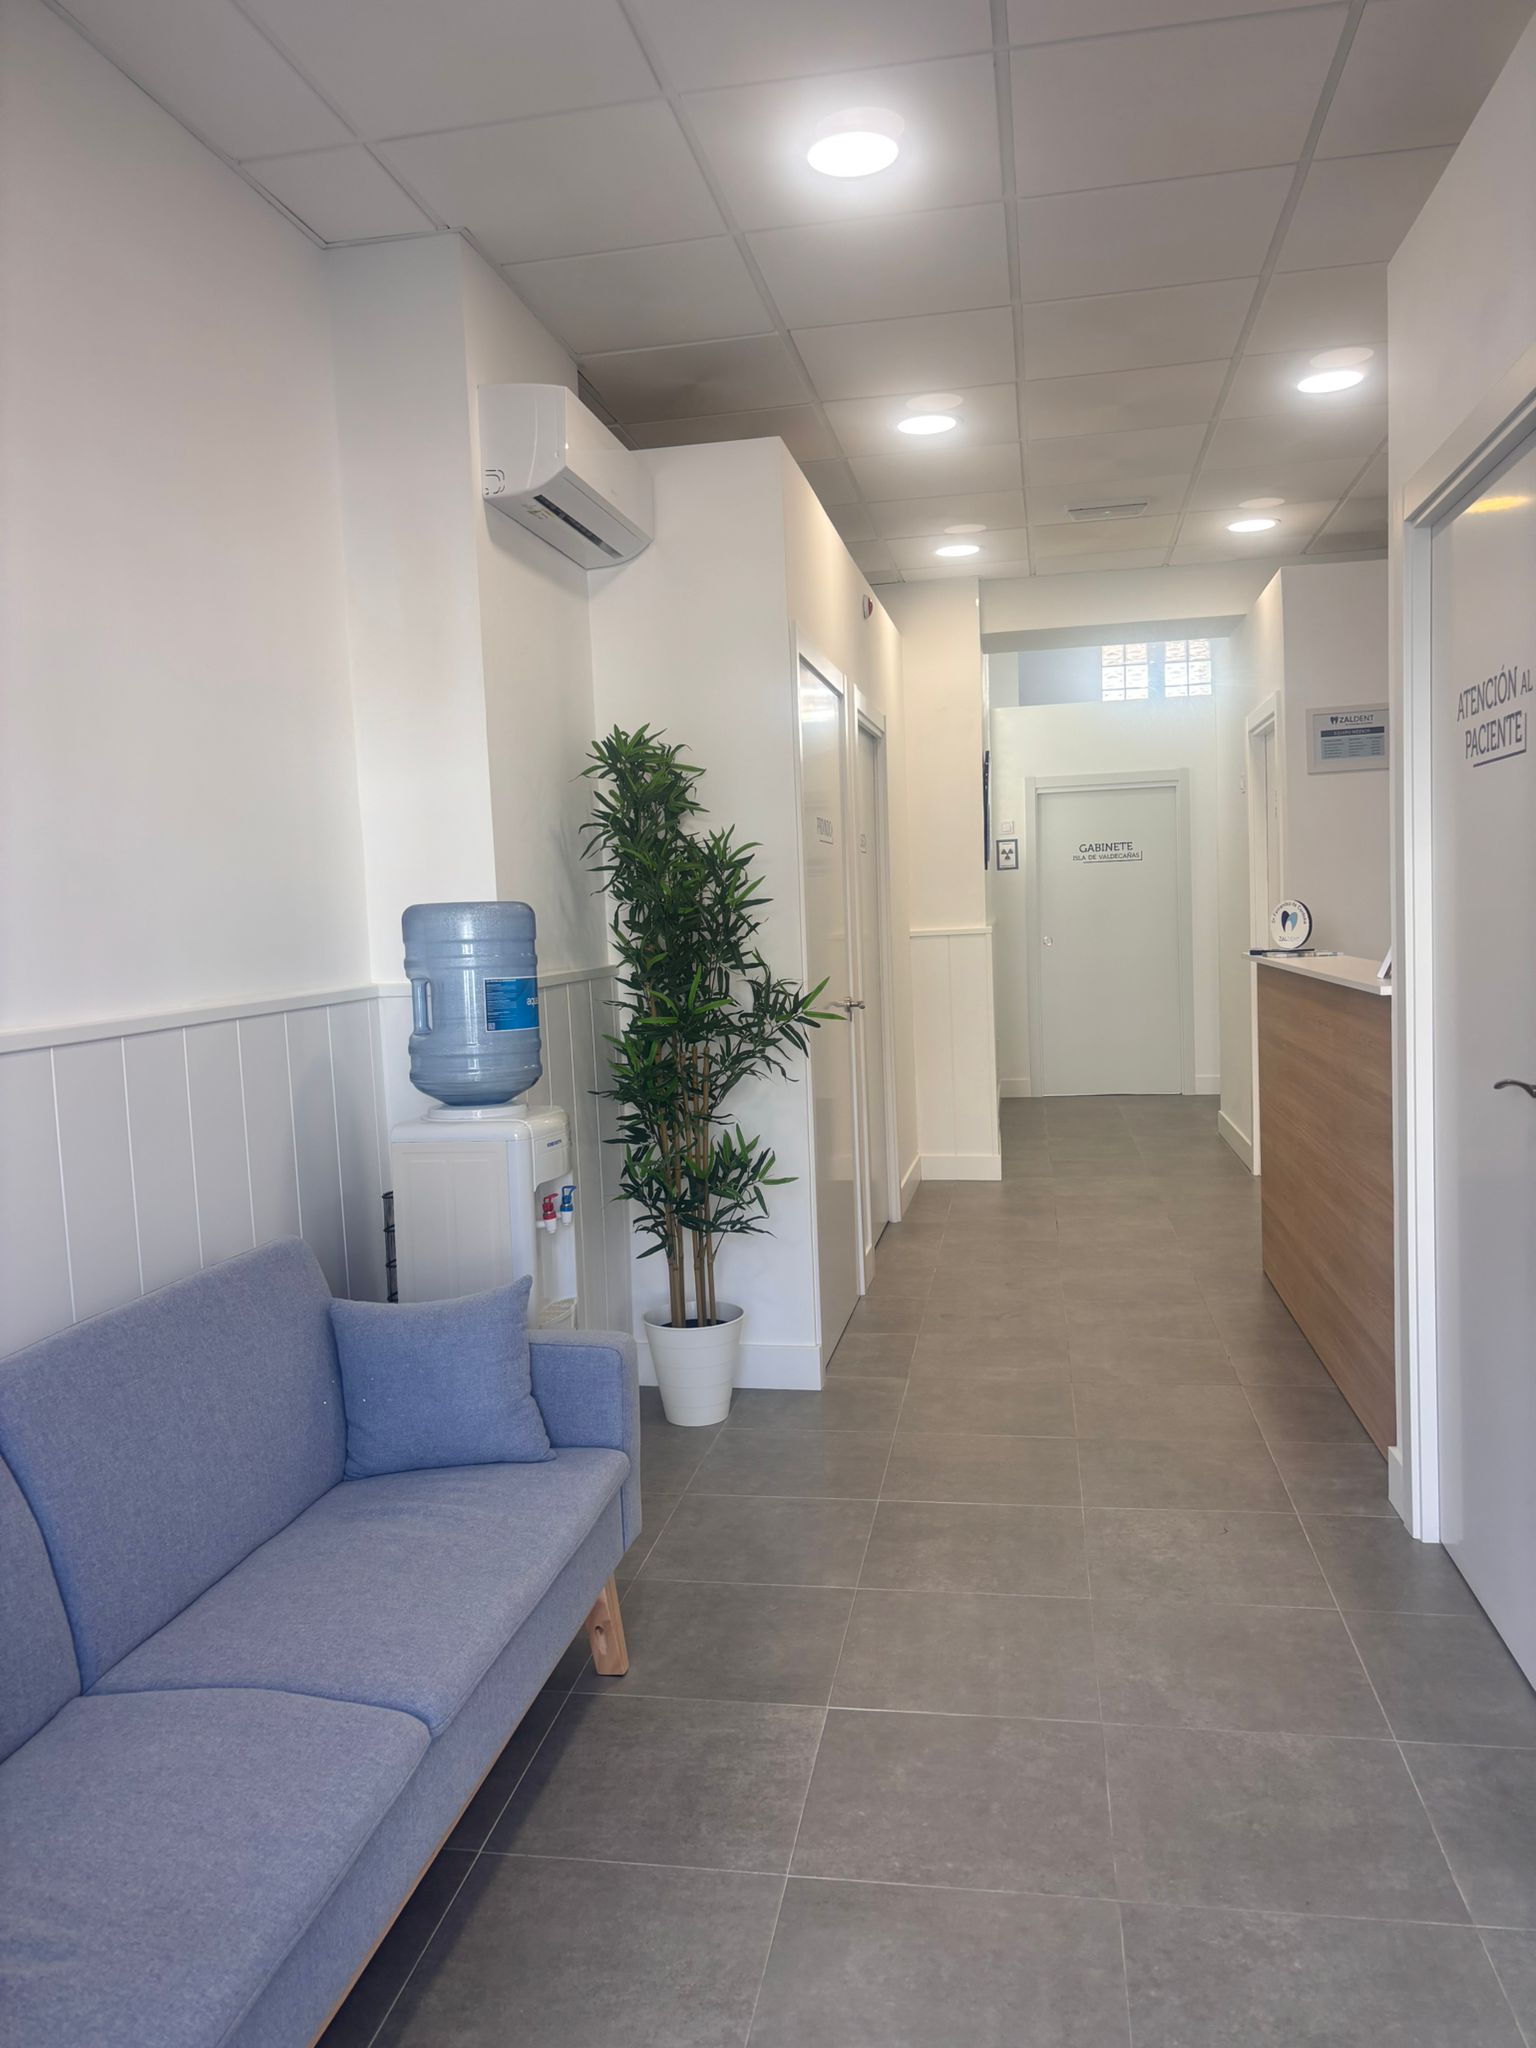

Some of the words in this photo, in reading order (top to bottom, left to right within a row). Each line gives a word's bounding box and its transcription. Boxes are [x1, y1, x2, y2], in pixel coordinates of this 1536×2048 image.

[1457, 664, 1518, 722] ATENCIÓN
[1520, 669, 1534, 696] AL
[1339, 714, 1374, 724] ZALDENT
[1465, 710, 1522, 760] PACIENTE
[1079, 841, 1133, 853] GABINETE
[1098, 851, 1140, 860] VALDECAÑAS
